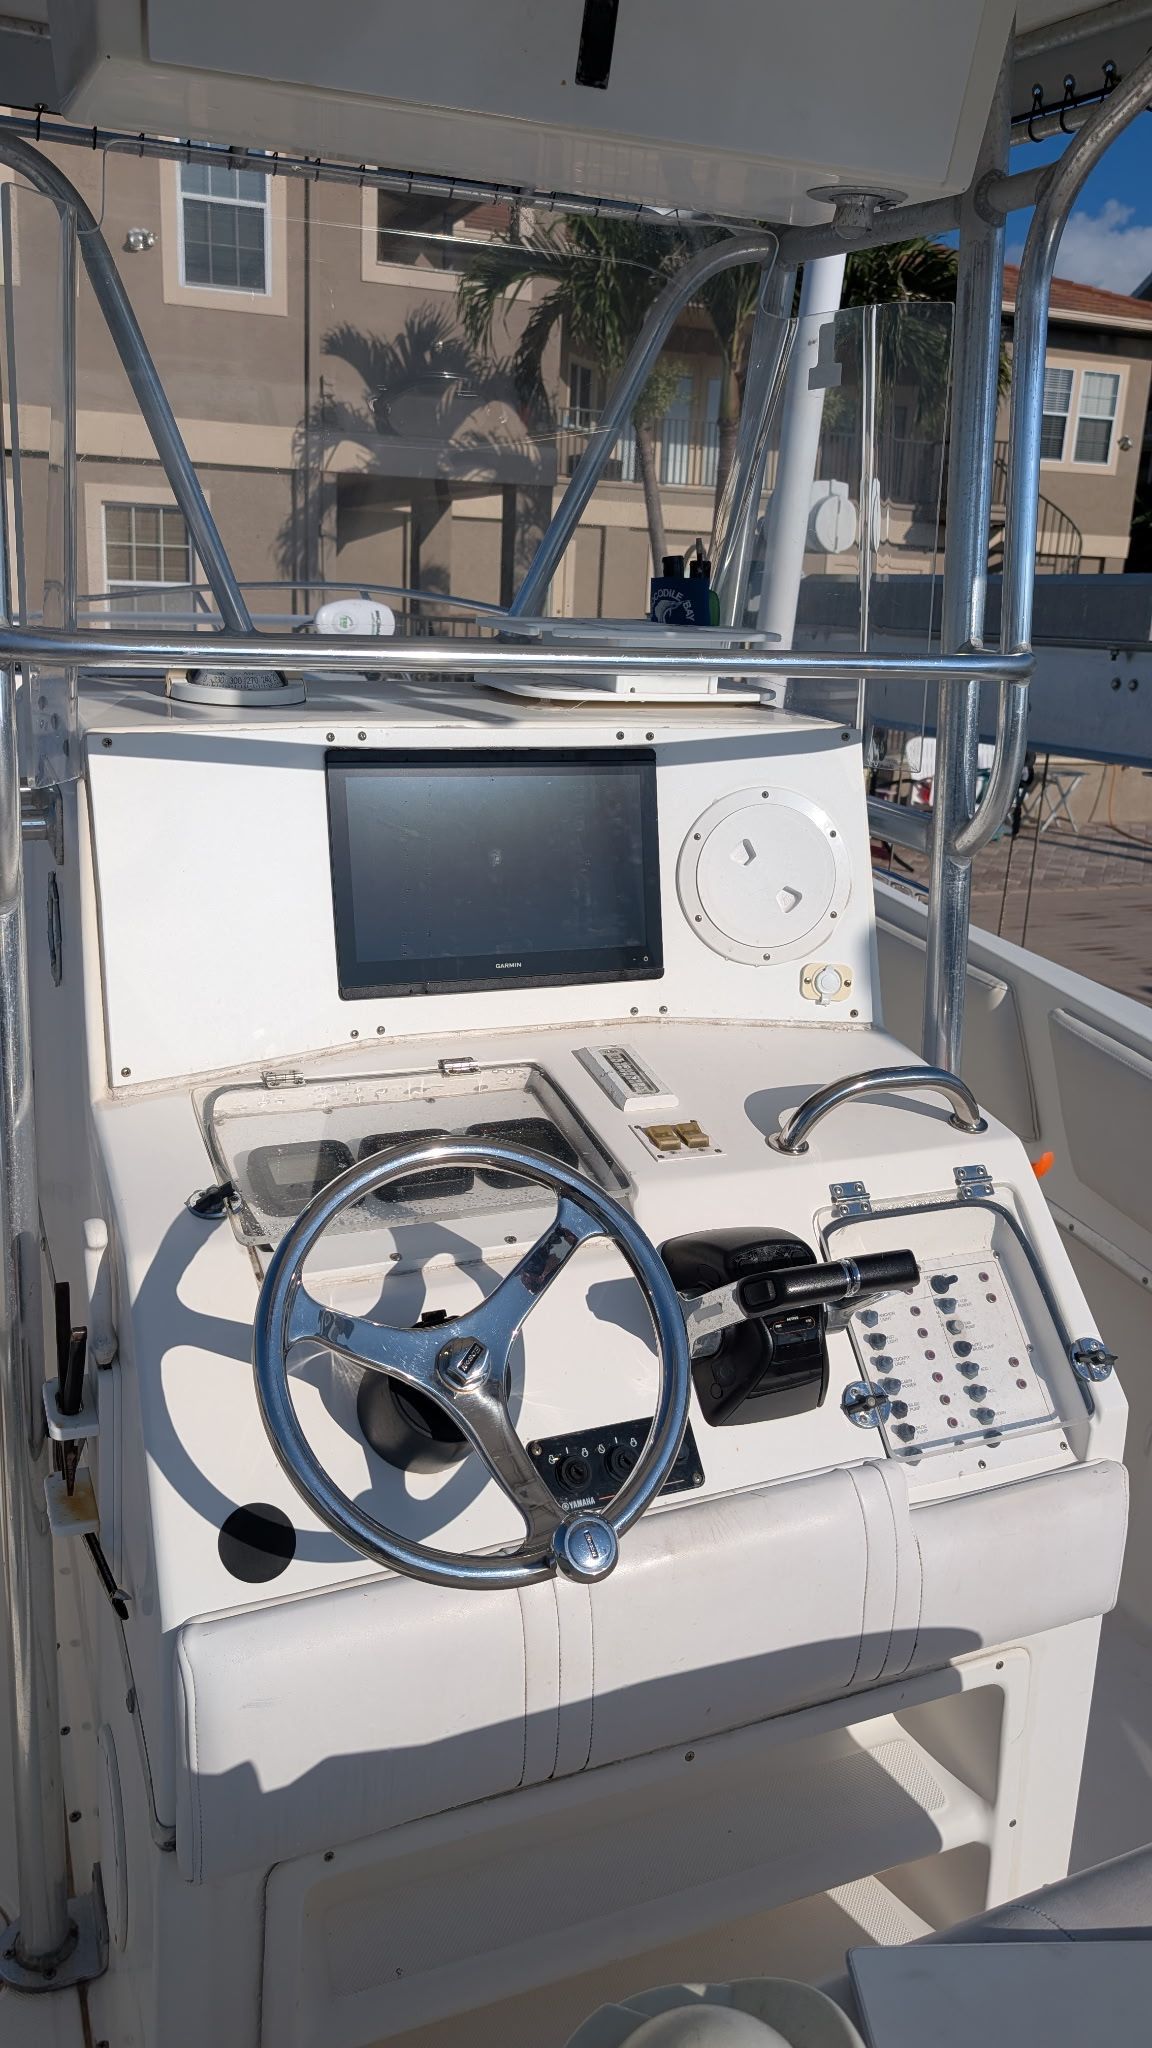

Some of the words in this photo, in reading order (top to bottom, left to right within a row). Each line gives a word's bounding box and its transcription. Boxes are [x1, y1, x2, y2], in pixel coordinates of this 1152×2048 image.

[653, 588, 684, 605] CODILE
[682, 600, 695, 622] BAY
[229, 676, 242, 685] 300
[246, 676, 259, 685] 270
[460, 1344, 481, 1372] EDSON
[568, 1496, 596, 1510] YAMAHA
